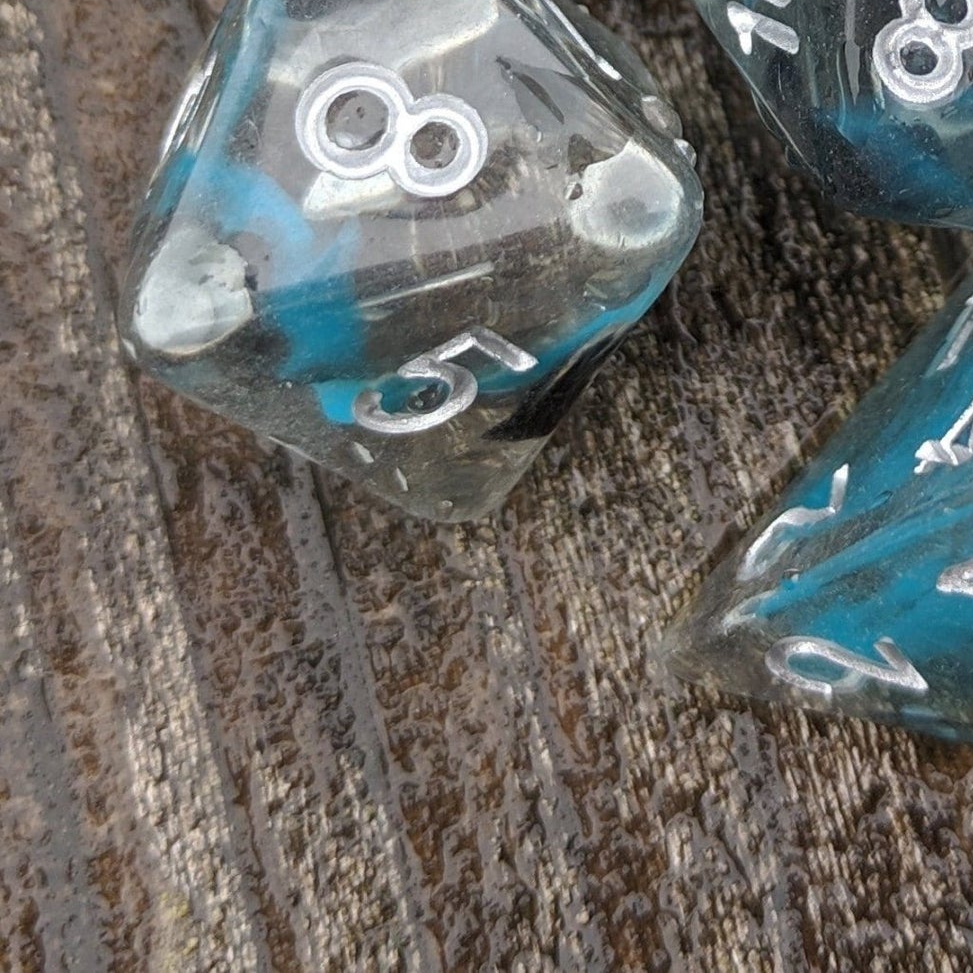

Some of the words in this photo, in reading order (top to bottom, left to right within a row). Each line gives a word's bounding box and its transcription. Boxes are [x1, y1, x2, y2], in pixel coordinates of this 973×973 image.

[295, 62, 489, 198] 8
[352, 328, 539, 434] 5
[765, 636, 929, 699] 2
